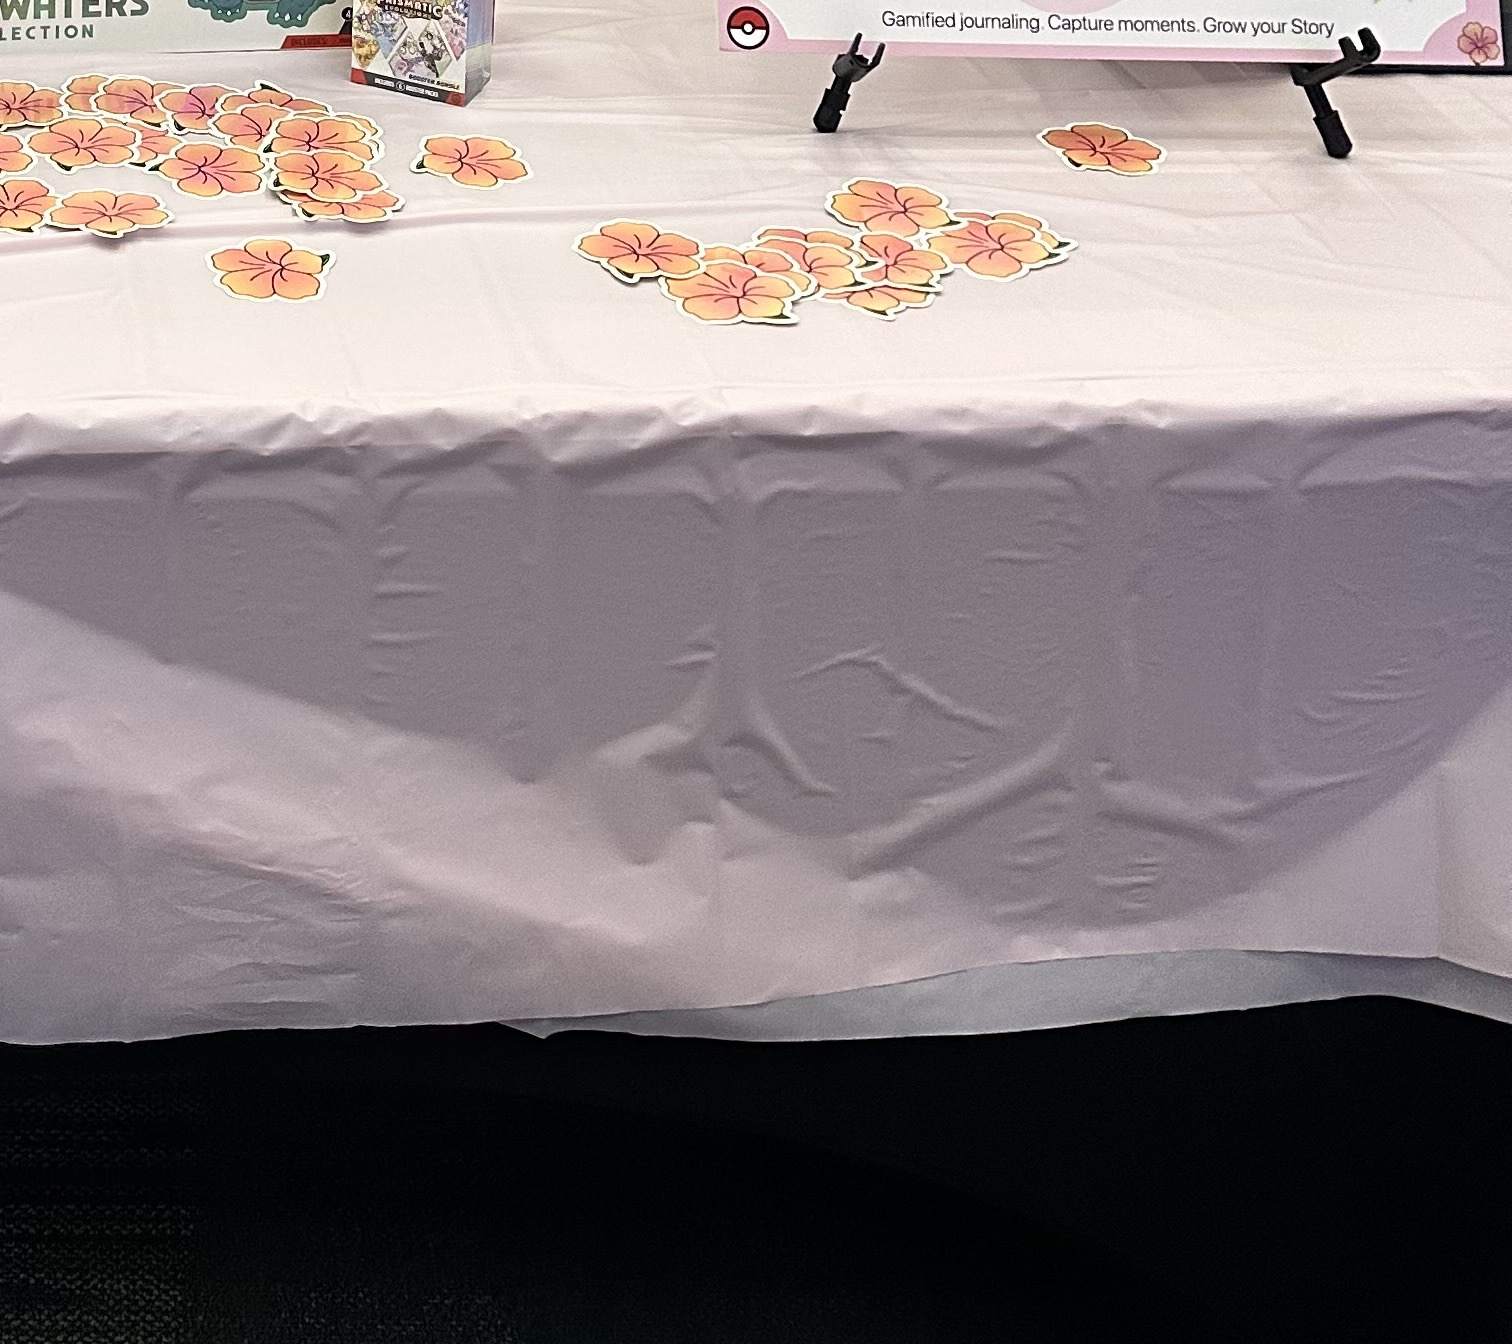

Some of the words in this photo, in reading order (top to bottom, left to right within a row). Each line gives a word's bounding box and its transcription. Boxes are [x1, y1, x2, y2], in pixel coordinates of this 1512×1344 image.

[881, 10, 956, 29] Gamified
[959, 12, 1045, 33] journaling.
[1047, 14, 1115, 34] Capture
[1118, 18, 1201, 33] moments.
[1203, 16, 1248, 33] Grow
[1250, 20, 1288, 37] your
[1291, 17, 1335, 38] Story
